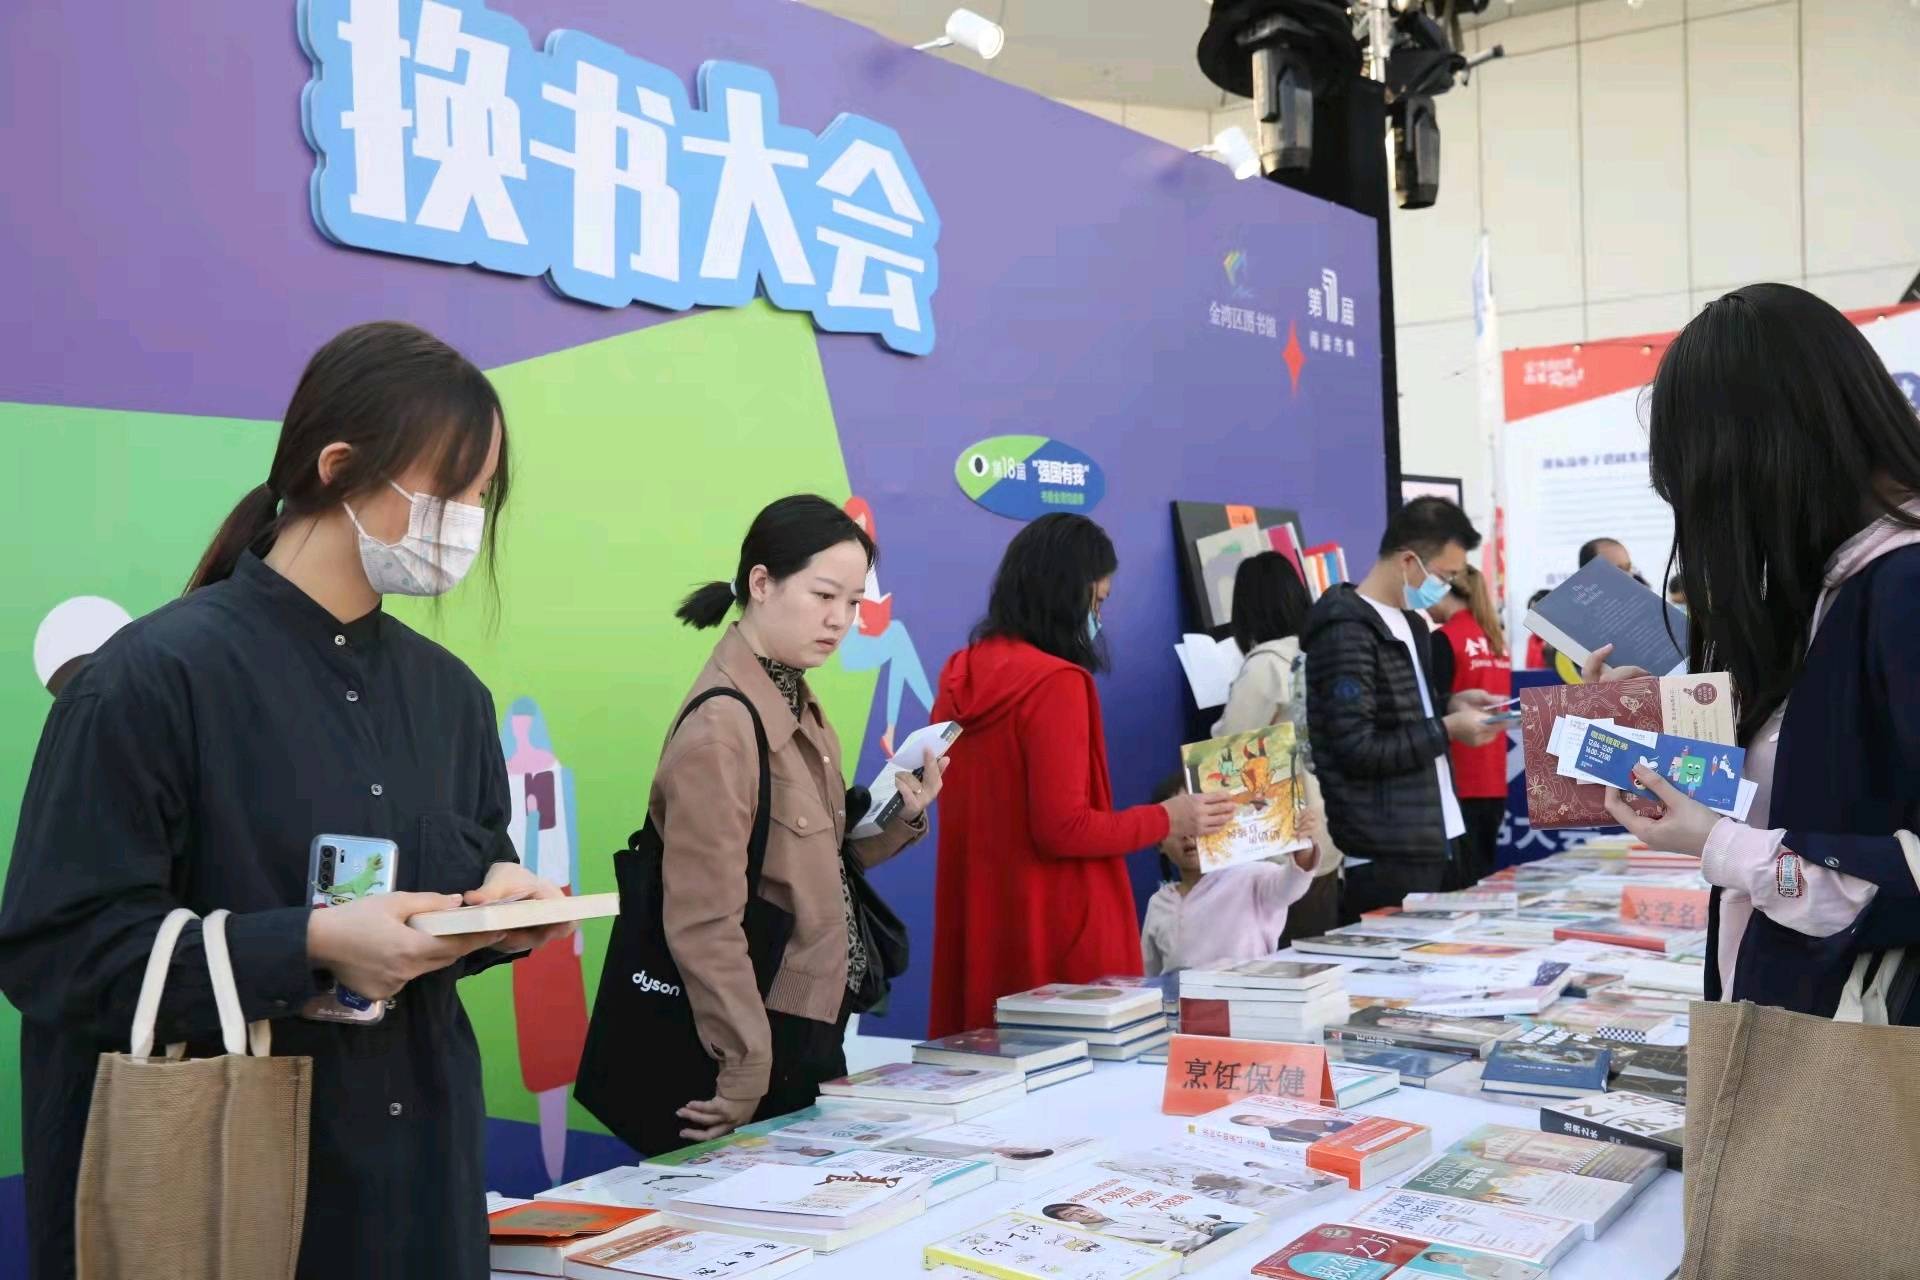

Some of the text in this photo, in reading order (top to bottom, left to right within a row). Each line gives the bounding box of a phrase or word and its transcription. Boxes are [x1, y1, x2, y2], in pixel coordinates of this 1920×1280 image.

[336, 0, 926, 332] 换书大会
[632, 970, 680, 996] dyson
[1182, 1058, 1307, 1098] 烹饪保健
